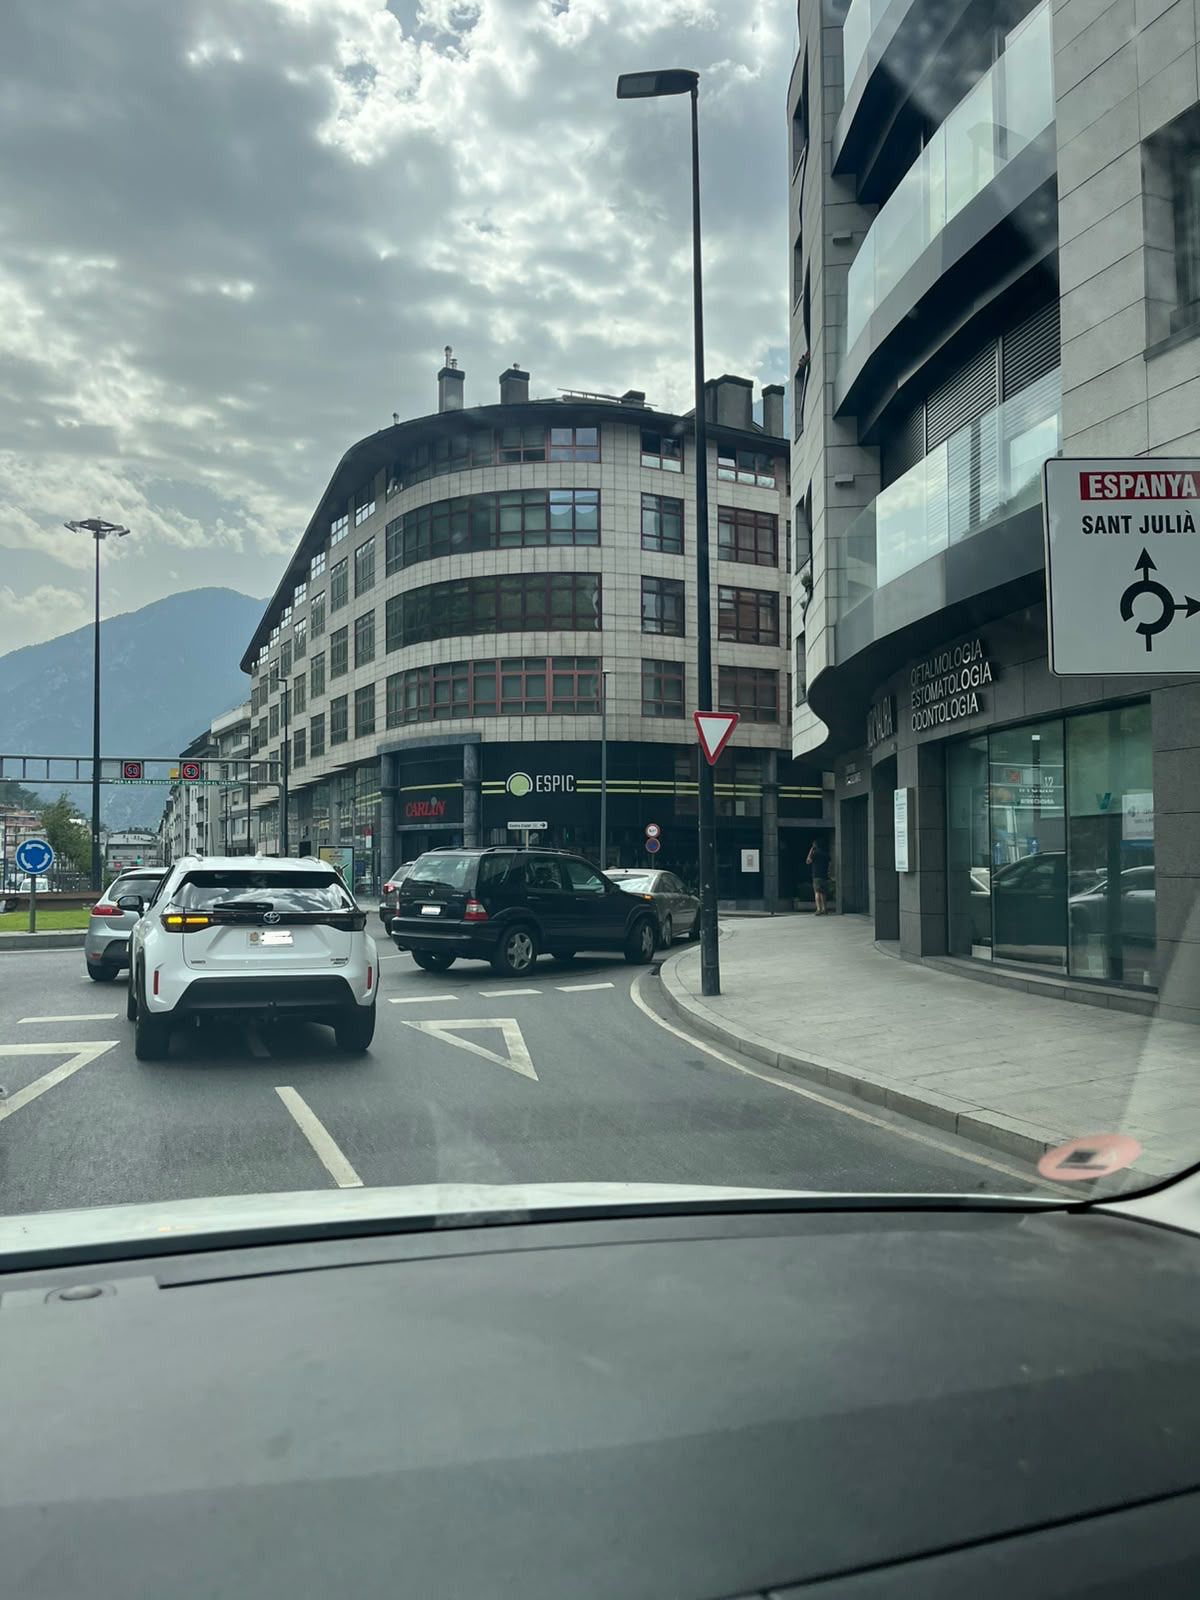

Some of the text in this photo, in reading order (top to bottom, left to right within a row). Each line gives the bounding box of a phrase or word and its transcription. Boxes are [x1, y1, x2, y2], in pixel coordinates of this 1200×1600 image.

[1088, 474, 1198, 498] ESPANYA
[1082, 510, 1196, 535] SANT JULIÀ
[911, 639, 983, 687] OFTALMOLOGIA
[911, 661, 993, 710] ESTOMATOLOGIA
[911, 692, 979, 732] ODONTOLOGIA
[127, 767, 138, 775] 50
[186, 766, 196, 775] 50
[536, 775, 574, 792] ESPIC
[405, 798, 446, 817] CARLIN
